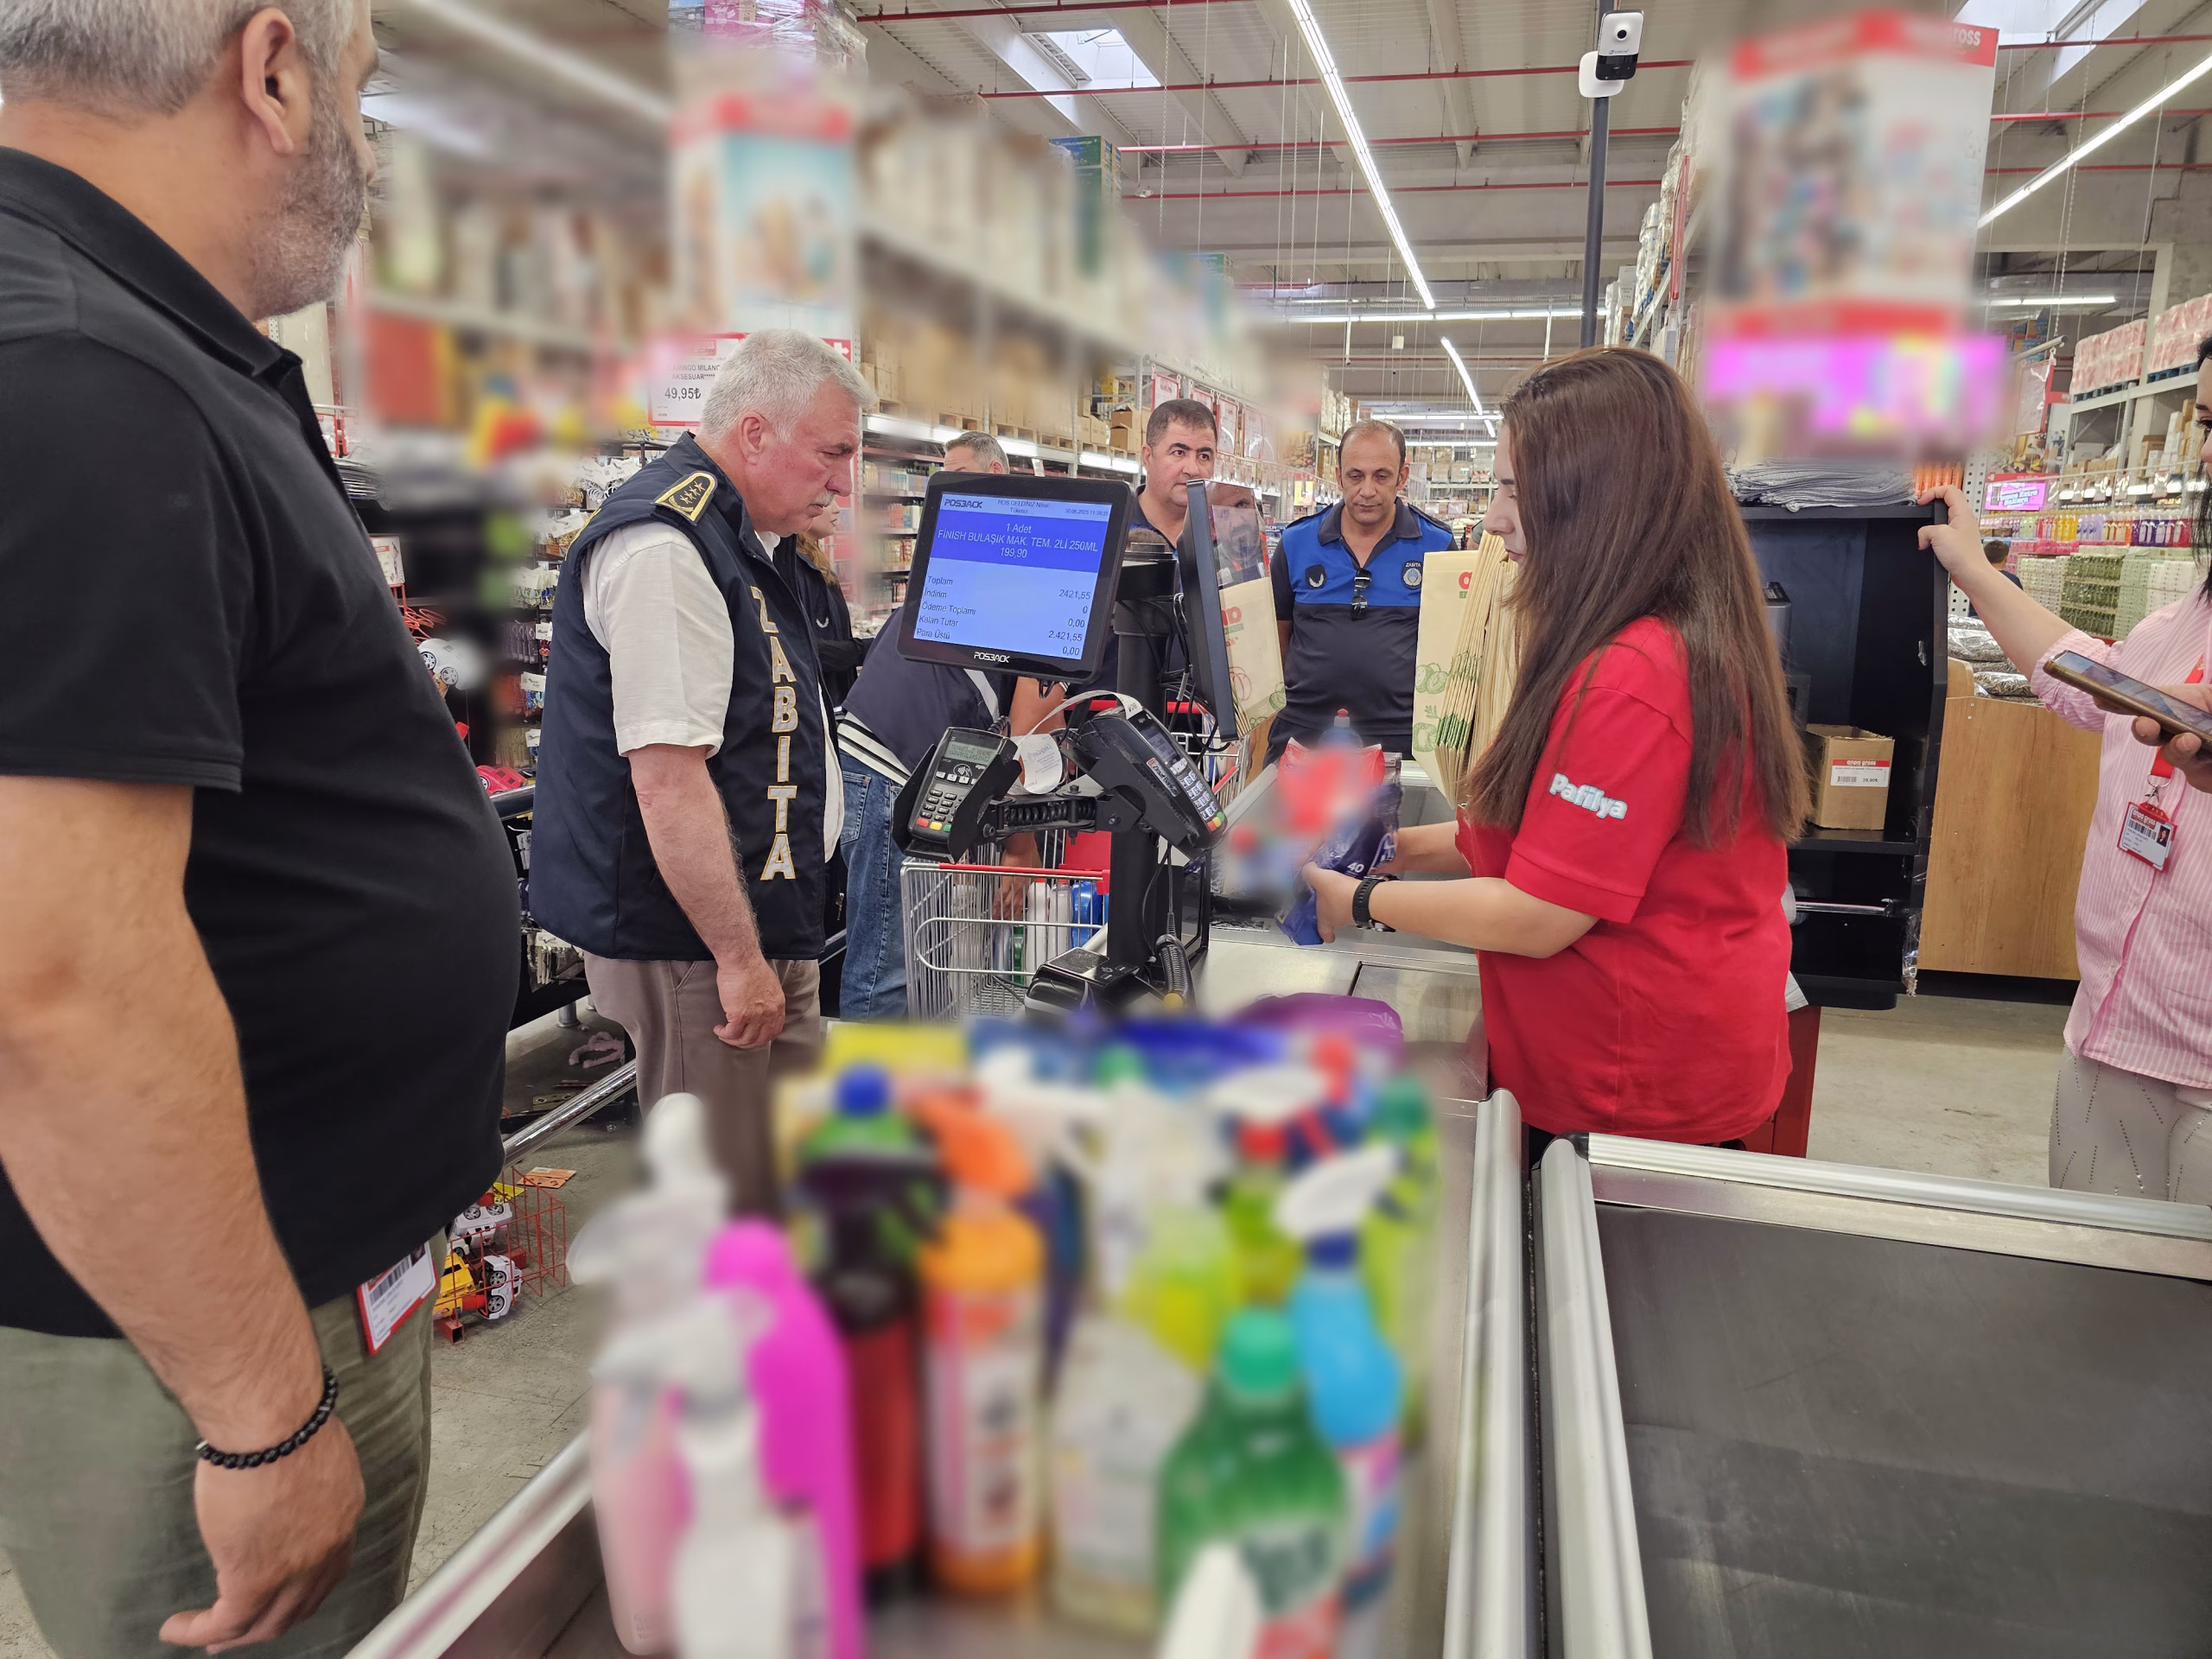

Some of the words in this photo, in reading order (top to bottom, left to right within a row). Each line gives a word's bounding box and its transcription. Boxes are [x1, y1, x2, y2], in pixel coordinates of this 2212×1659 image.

[1006, 523, 1010, 531] 1
[1012, 524, 1032, 534] Adet
[967, 532, 1005, 545] BULAŞIK
[1006, 535, 1028, 546] MAK.
[1031, 537, 1052, 548] TEM.
[1068, 540, 1098, 552] 250ML
[1000, 547, 1027, 558] 199,90
[927, 575, 953, 586] Toplam
[1058, 588, 1091, 600] 2421,55
[921, 601, 946, 612] Ödeme
[948, 605, 976, 616] Toplamı
[918, 615, 939, 625] Kalan
[940, 617, 959, 626] Tutar
[1067, 618, 1085, 628] 0,00
[916, 628, 933, 638] Para
[934, 629, 950, 639] Üstü
[1048, 630, 1083, 642] 2.421,55
[1062, 645, 1080, 656] 0,00
[750, 586, 798, 880] ZABITA
[1549, 772, 1628, 819] Pafilya
[1347, 861, 1365, 874] 40
